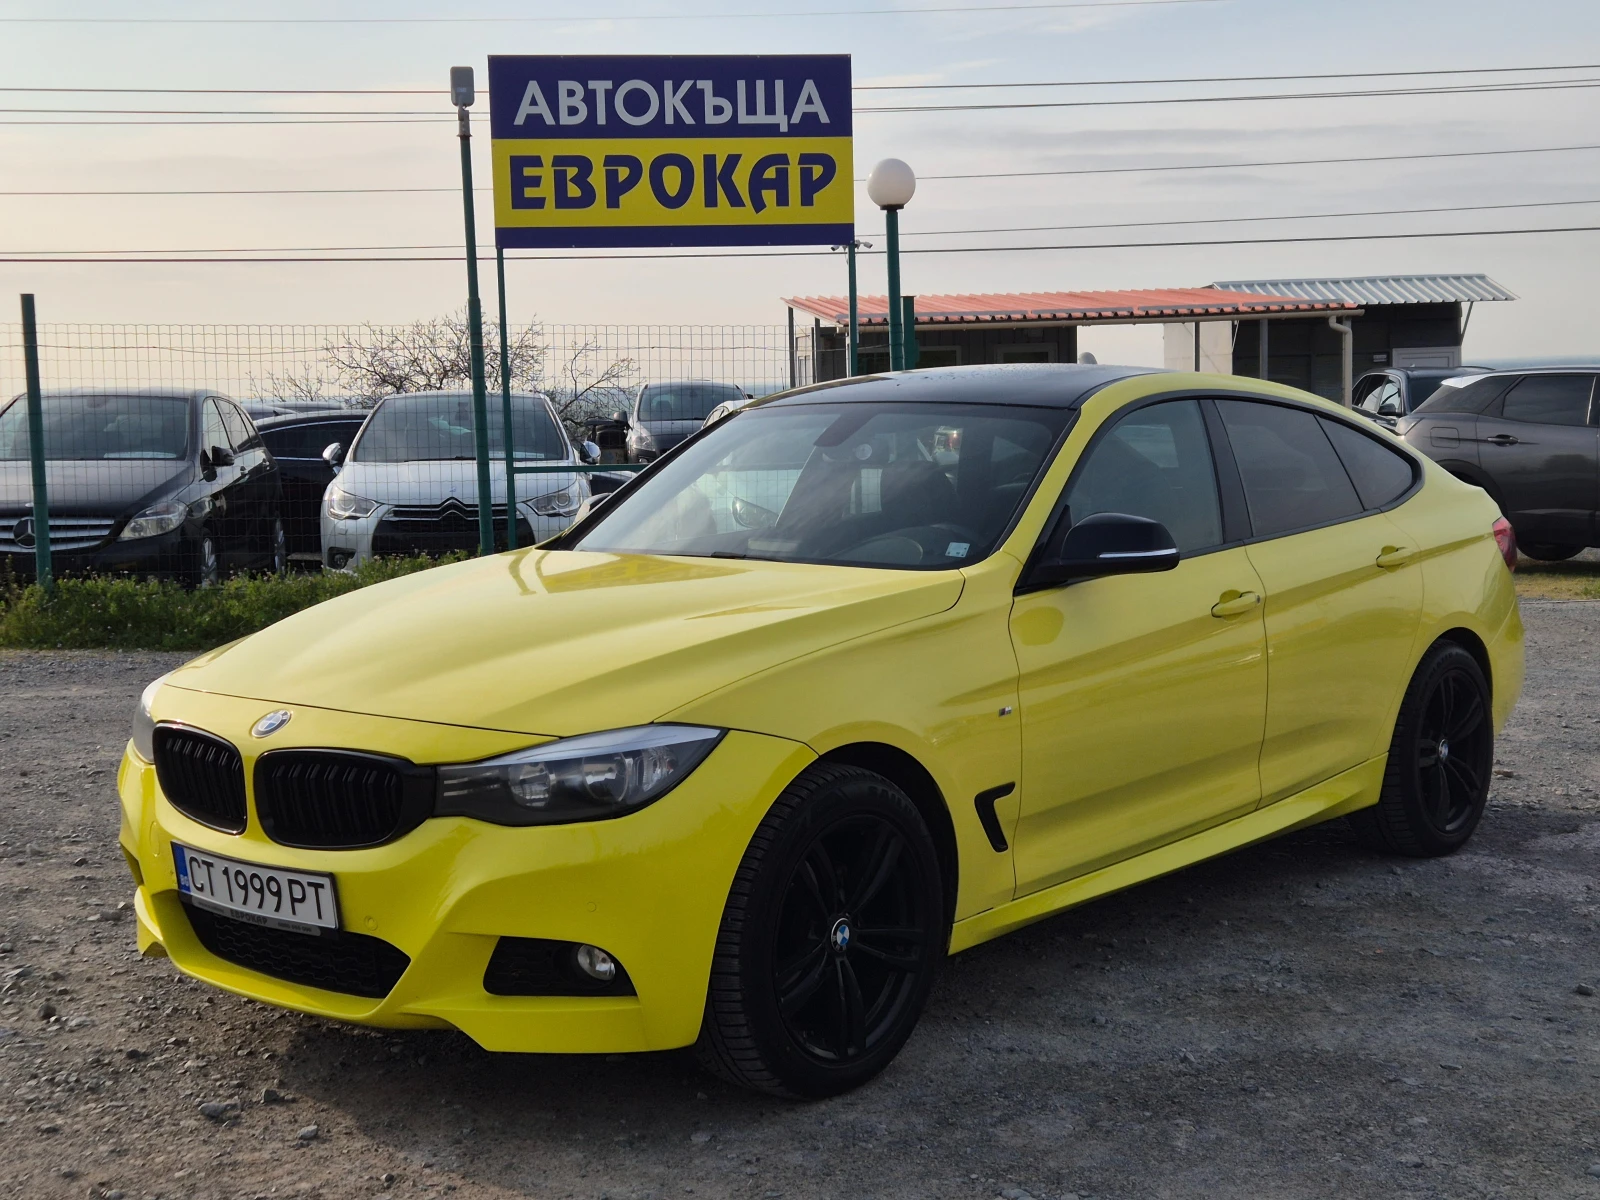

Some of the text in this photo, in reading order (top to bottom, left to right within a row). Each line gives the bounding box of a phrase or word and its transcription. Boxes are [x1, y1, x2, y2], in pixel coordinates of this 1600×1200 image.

[513, 79, 830, 132] АВТОКЪЩА
[509, 153, 837, 214] ЕВРОКАР
[222, 866, 282, 913] 1999
